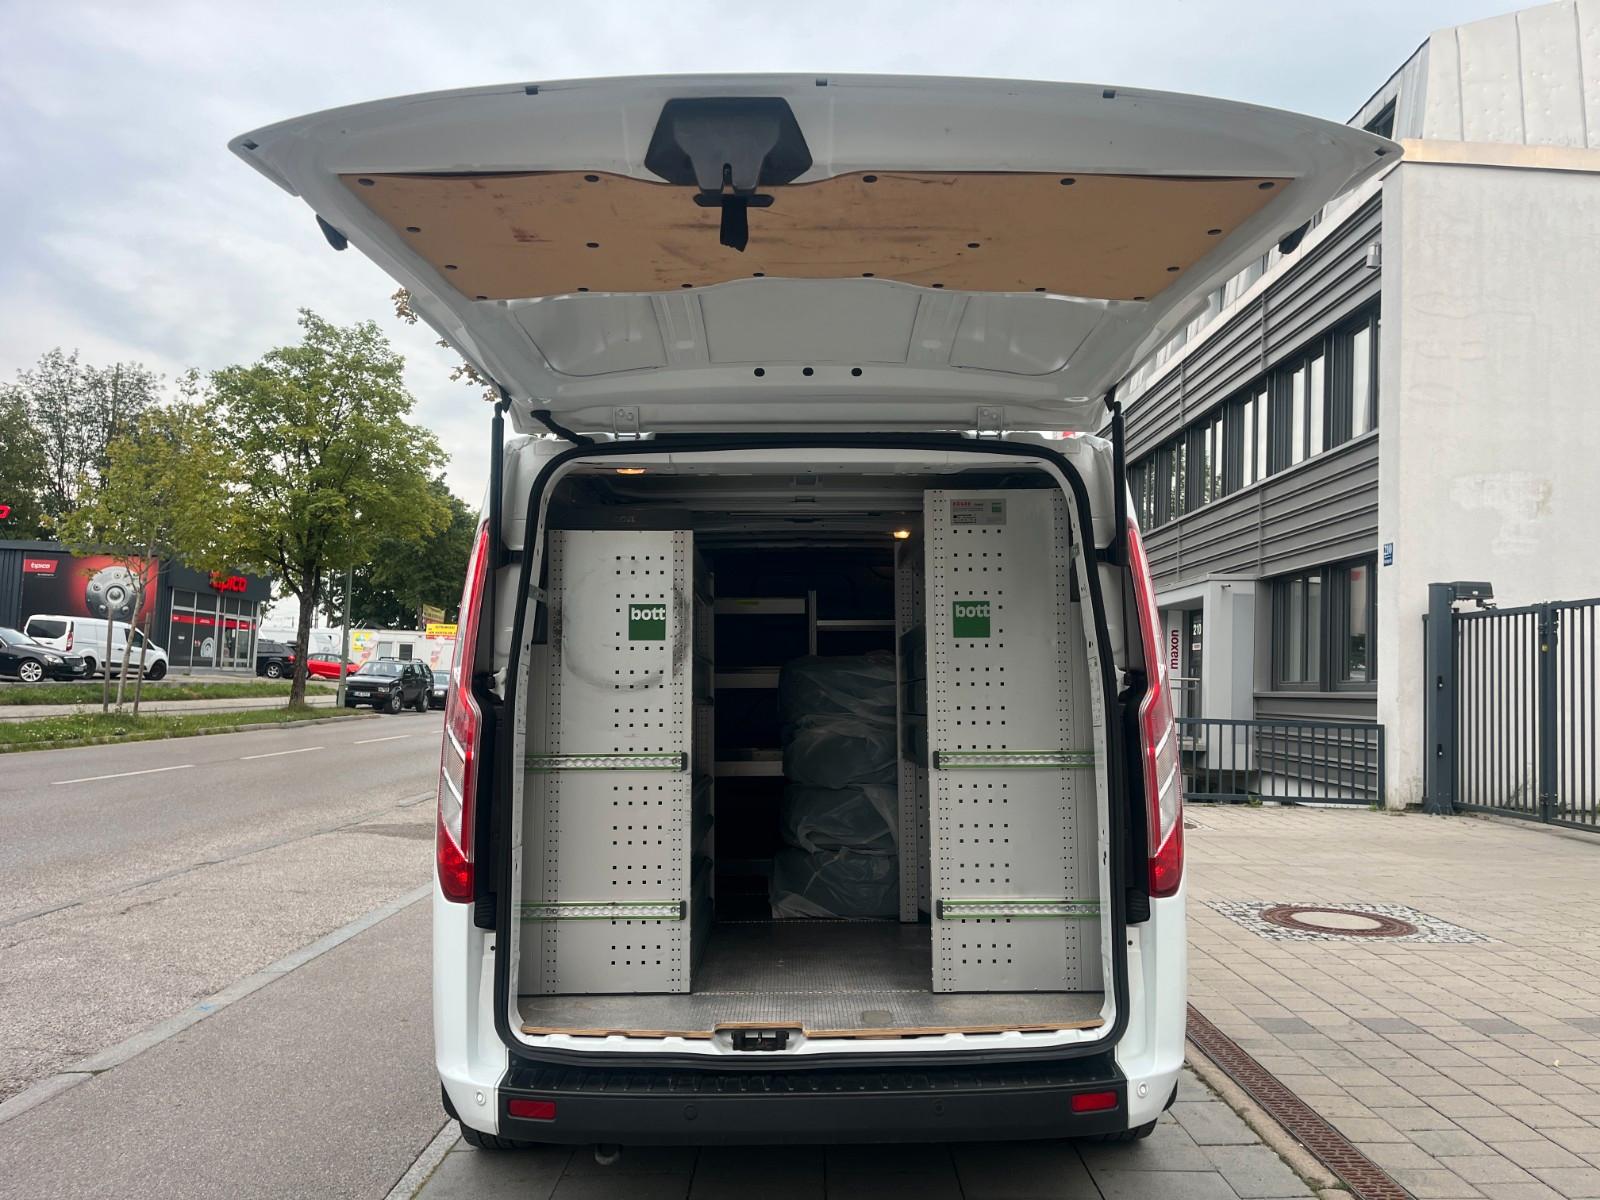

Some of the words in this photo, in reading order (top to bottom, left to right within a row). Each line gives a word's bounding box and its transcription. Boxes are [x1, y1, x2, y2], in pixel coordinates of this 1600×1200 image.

[631, 607, 666, 620] bott
[955, 604, 990, 618] bott
[1170, 629, 1179, 670] maxon
